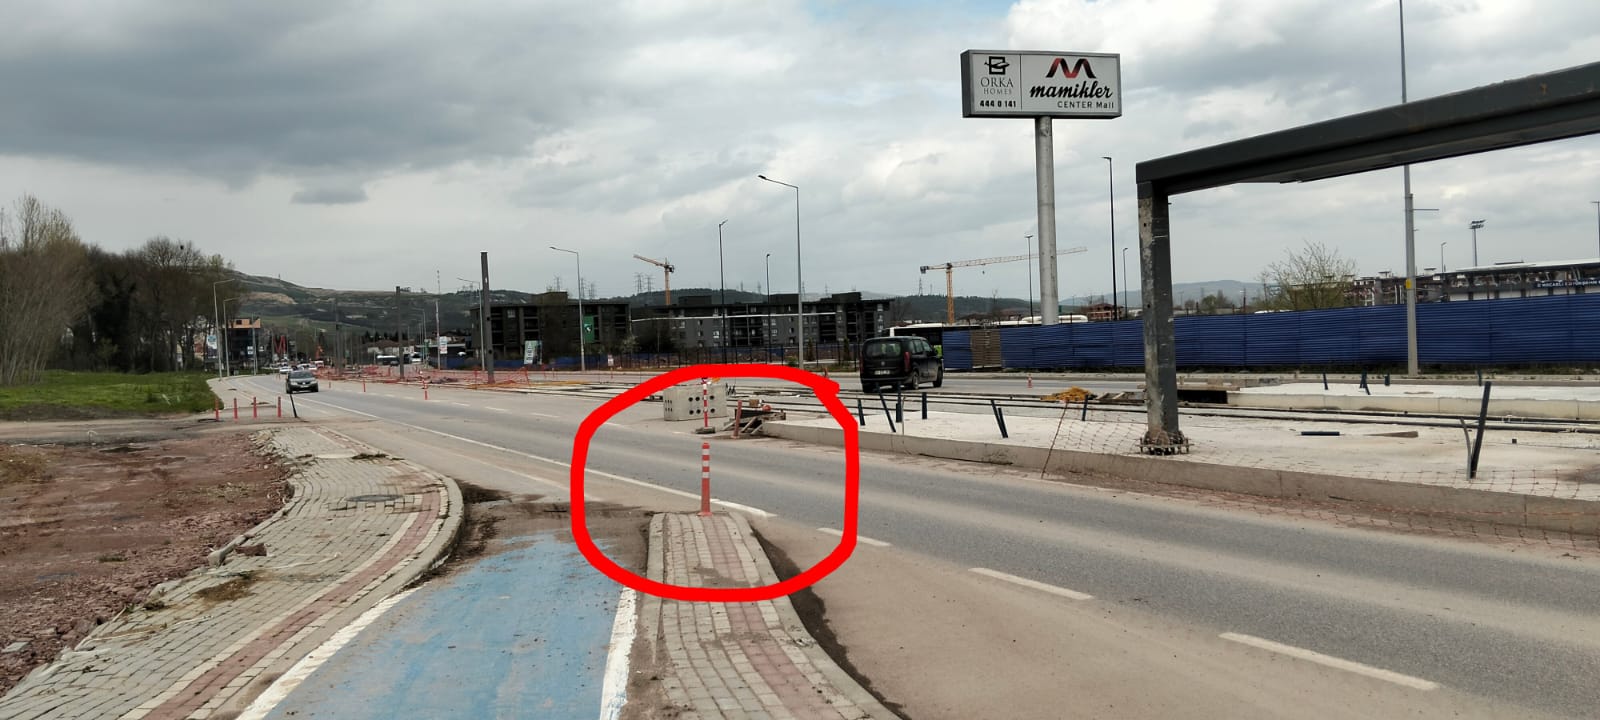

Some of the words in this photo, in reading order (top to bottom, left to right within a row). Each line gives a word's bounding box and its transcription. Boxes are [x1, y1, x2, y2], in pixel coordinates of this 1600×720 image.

[980, 77, 1013, 87] ORKA
[1029, 80, 1113, 98] mamikler
[1005, 100, 1016, 108] 141
[1057, 101, 1092, 109] CENTER
